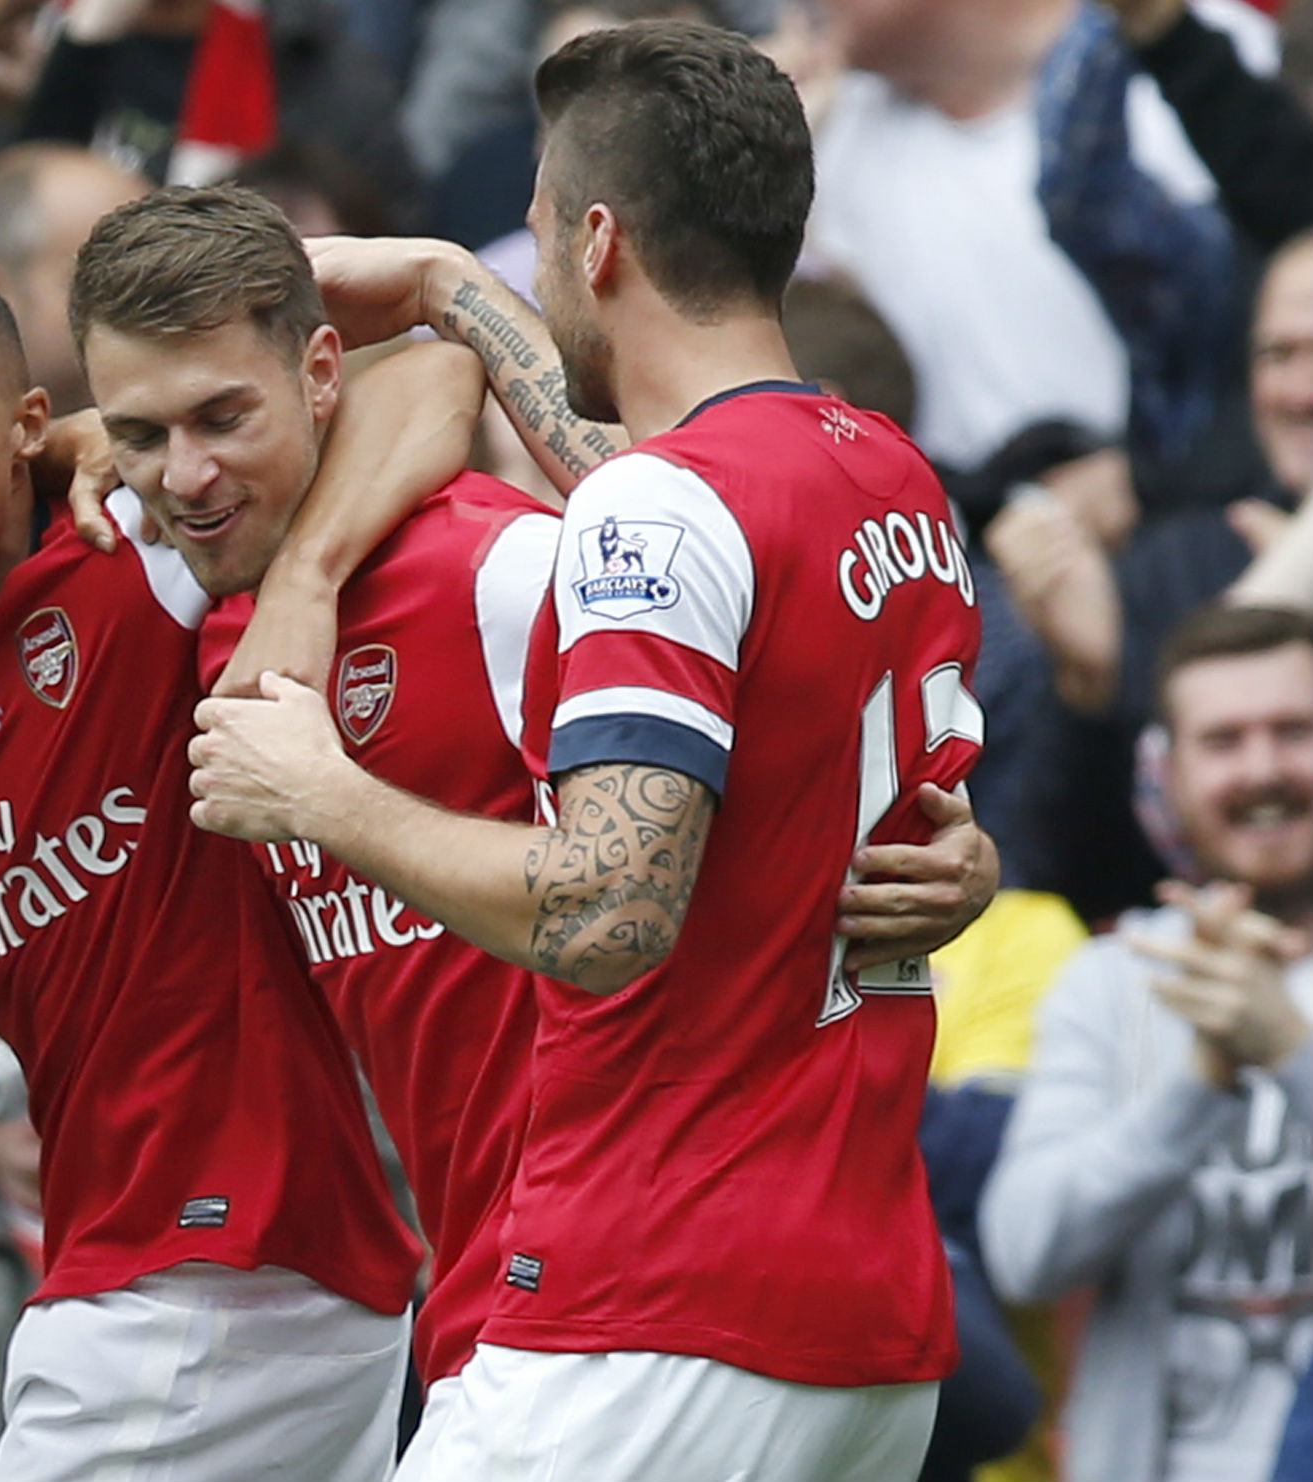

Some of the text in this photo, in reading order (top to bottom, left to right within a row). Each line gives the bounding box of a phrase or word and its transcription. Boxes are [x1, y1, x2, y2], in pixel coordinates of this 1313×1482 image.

[837, 511, 975, 621] GIROUD
[584, 577, 648, 597] BARCLAYS
[21, 621, 63, 652] Arsenal
[346, 658, 389, 681] Arsenal
